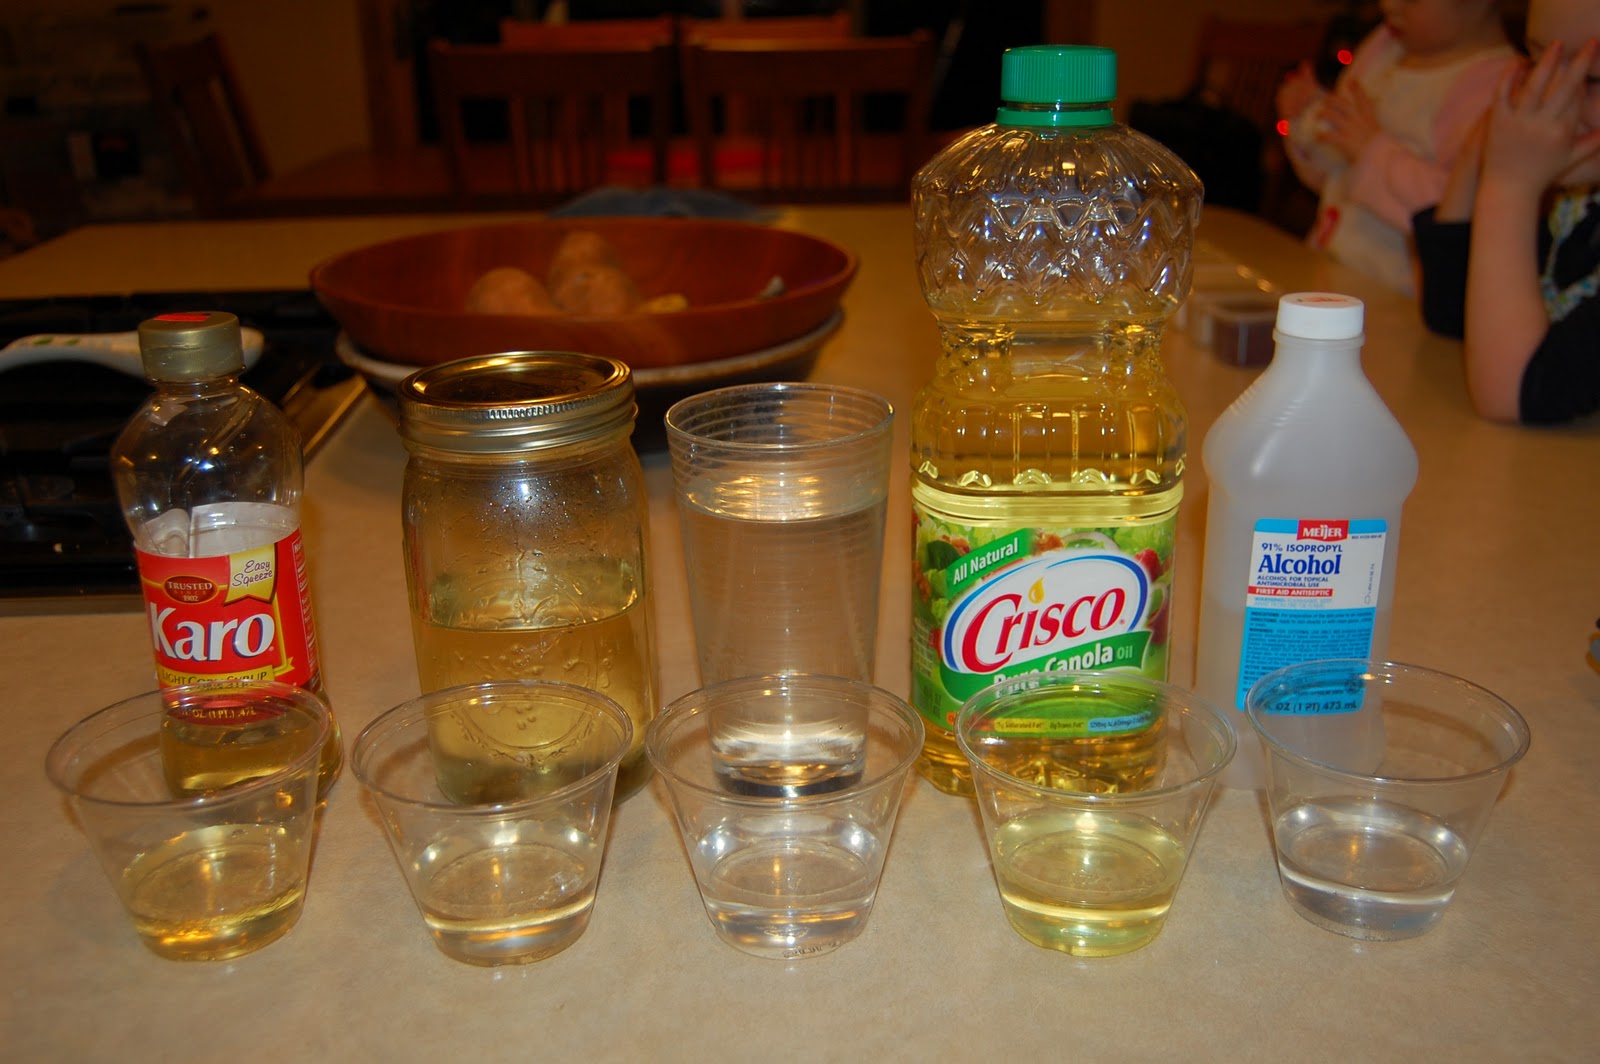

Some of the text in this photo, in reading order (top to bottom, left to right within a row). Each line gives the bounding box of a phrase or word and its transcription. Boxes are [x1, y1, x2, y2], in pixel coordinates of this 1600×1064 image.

[1261, 543, 1343, 553] 91% ISOPROPYL
[244, 560, 271, 573] Easy
[953, 537, 1019, 585] All Natural
[1258, 554, 1342, 575] Alcohol
[167, 581, 213, 591] TRUSTED
[232, 570, 273, 587] Squeeze
[149, 602, 275, 662] Karo
[962, 588, 1126, 674] Crisco
[1045, 643, 1114, 671] Canola
[1116, 645, 1133, 660] Oil
[162, 669, 187, 685] LIGHT
[1276, 703, 1290, 711] OZ
[1323, 702, 1342, 710] 473
